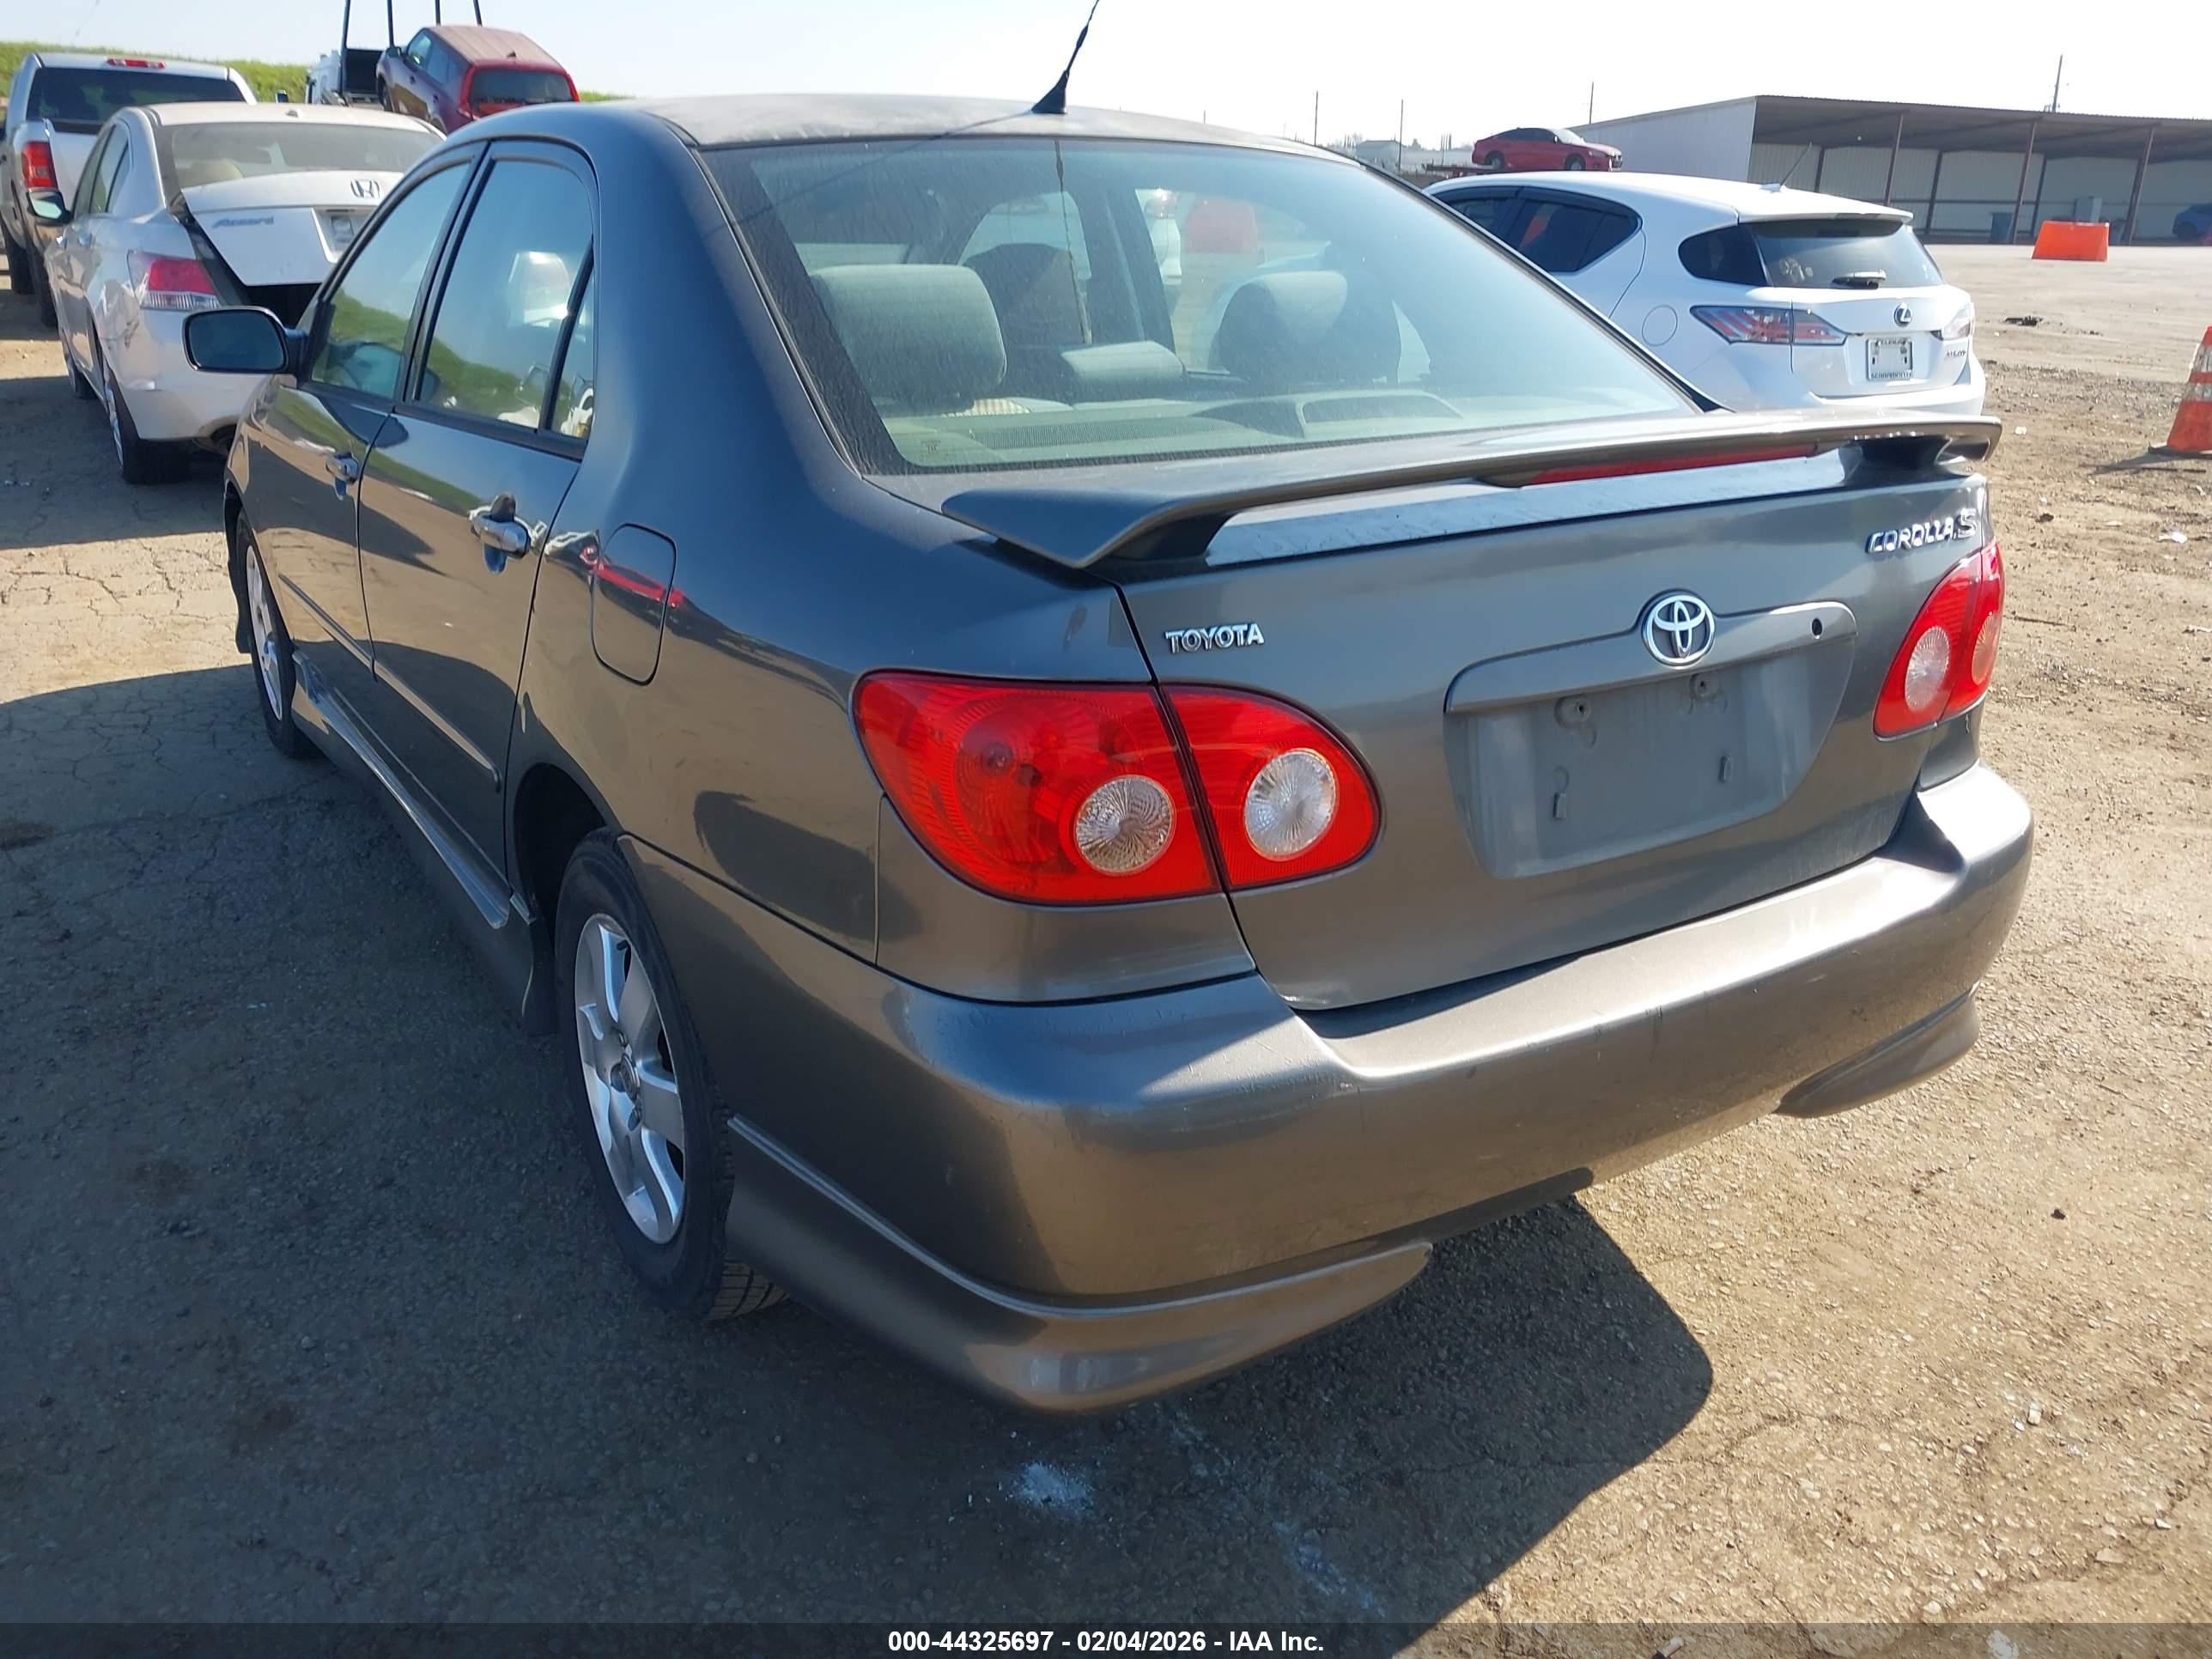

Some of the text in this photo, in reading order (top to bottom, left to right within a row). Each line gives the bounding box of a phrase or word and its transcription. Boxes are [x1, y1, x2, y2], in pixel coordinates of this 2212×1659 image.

[1867, 508, 1978, 553] COROLLA S
[1165, 623, 1265, 653] TOYOTA
